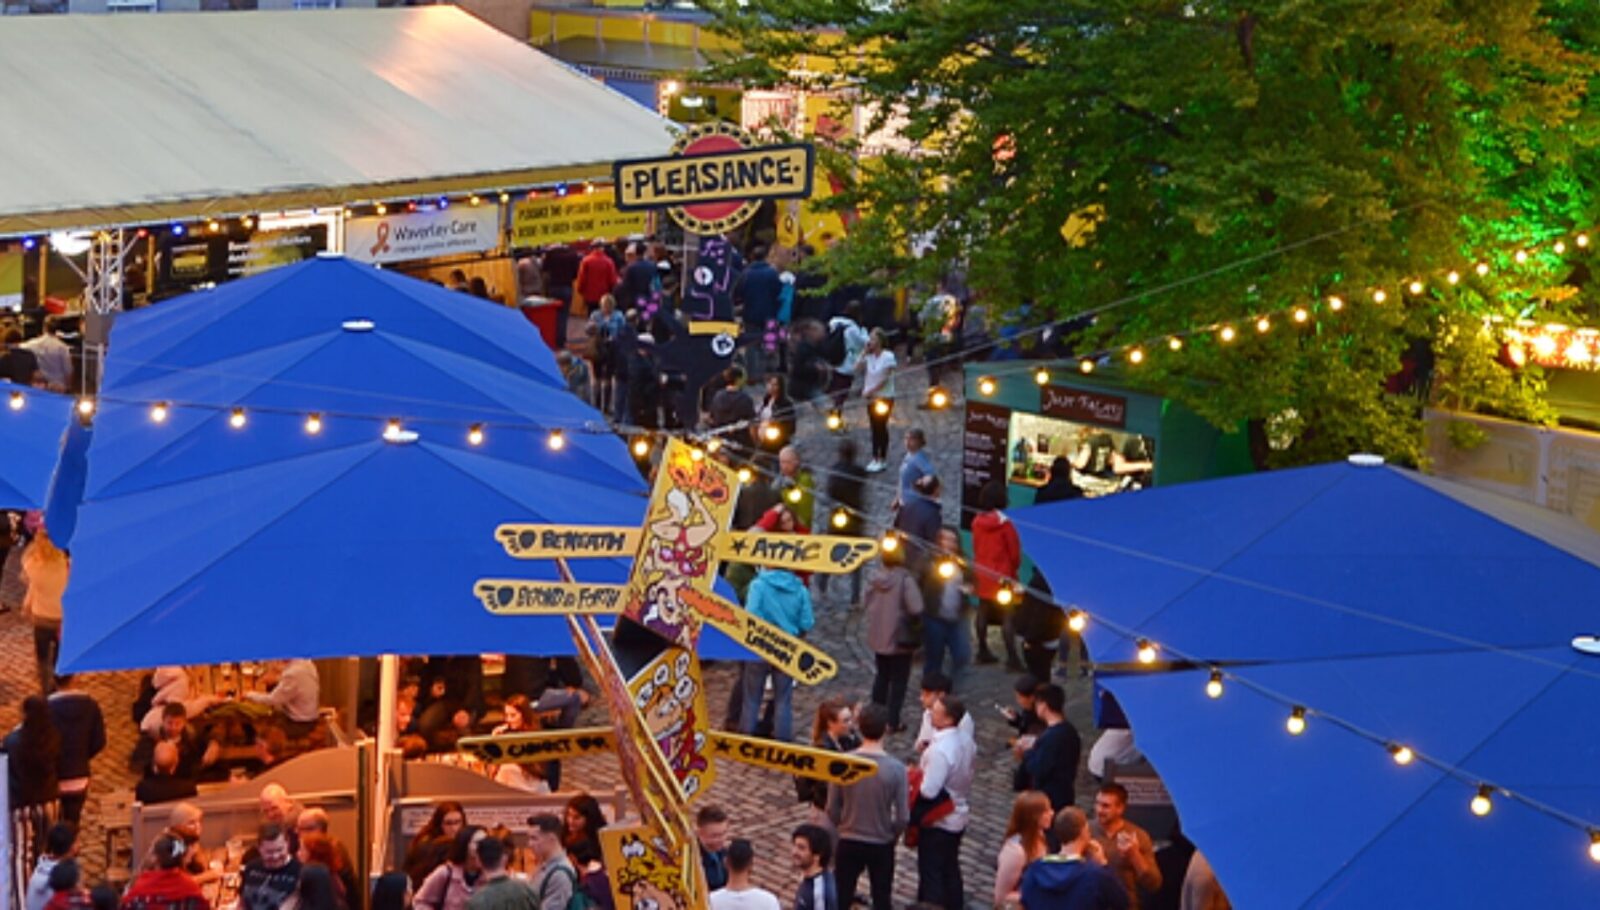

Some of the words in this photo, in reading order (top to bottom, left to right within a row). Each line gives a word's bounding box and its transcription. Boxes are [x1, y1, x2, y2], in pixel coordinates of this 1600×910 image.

[632, 156, 793, 199] PLEASANCE
[394, 222, 449, 242] Waverley
[451, 219, 478, 236] Care
[541, 529, 626, 551] BENEATH
[576, 587, 621, 609] FORTH
[738, 741, 817, 771] CELLAR
